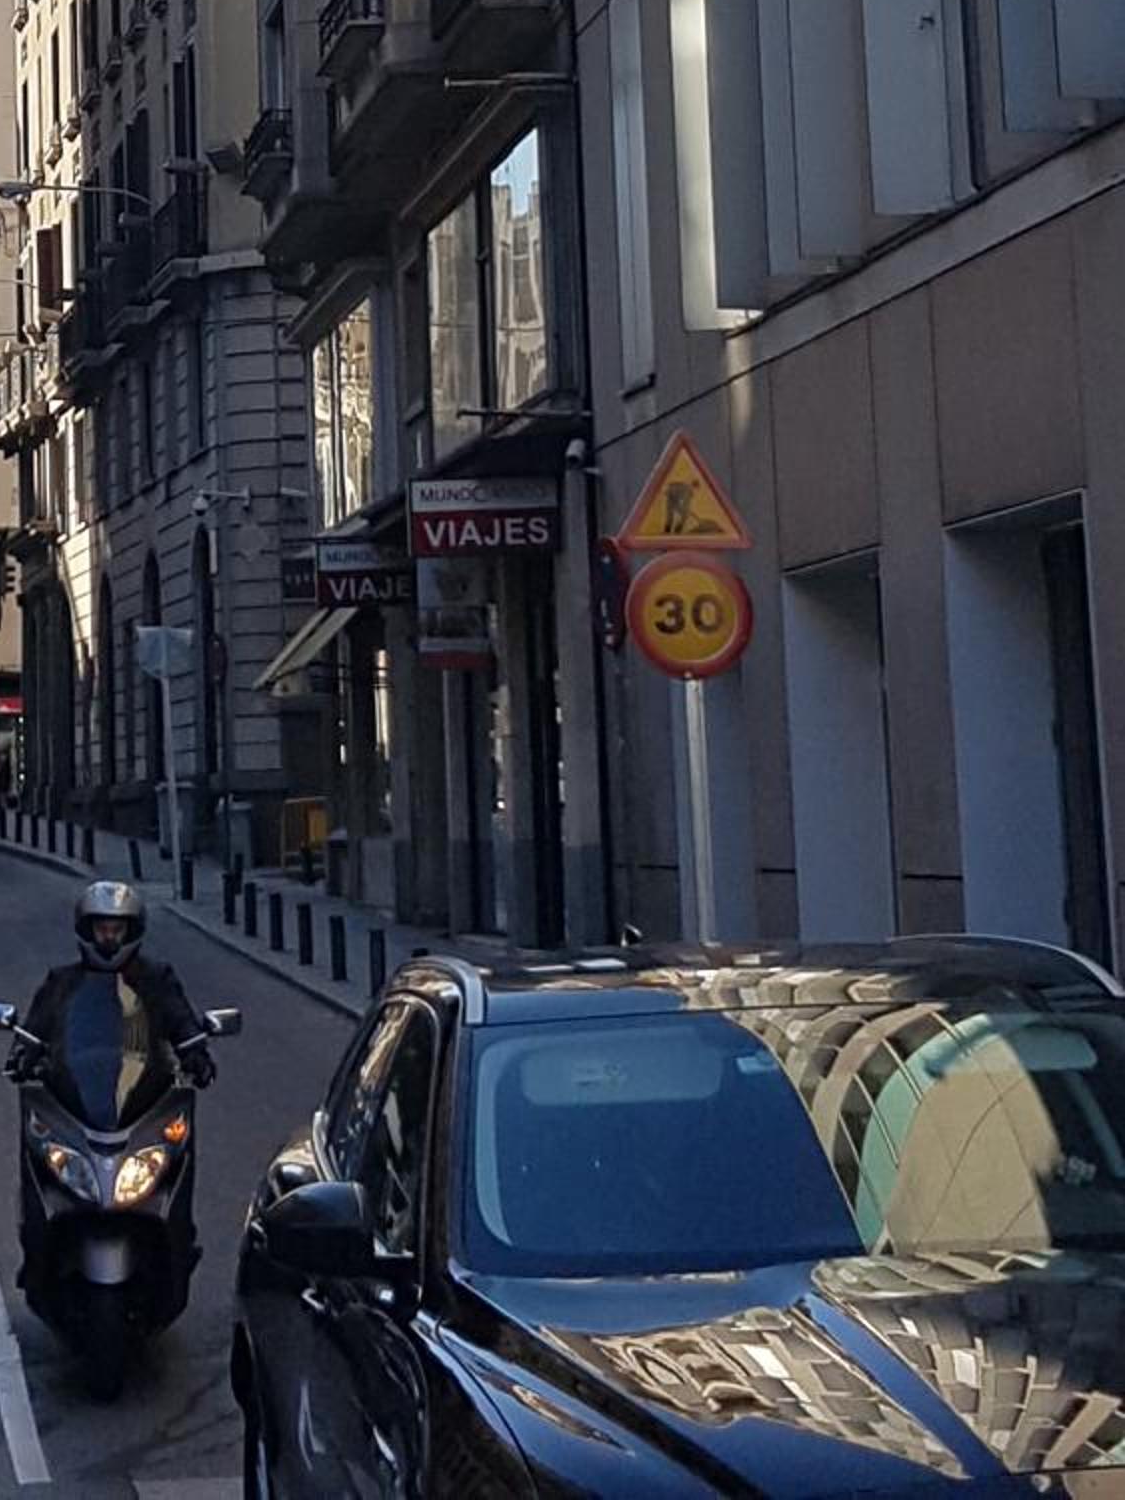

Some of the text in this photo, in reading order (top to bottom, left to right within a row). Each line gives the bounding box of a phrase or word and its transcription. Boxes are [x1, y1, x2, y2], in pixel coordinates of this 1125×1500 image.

[423, 516, 550, 548] VIAJES
[327, 576, 412, 601] VIAJE
[654, 594, 724, 634] 30
